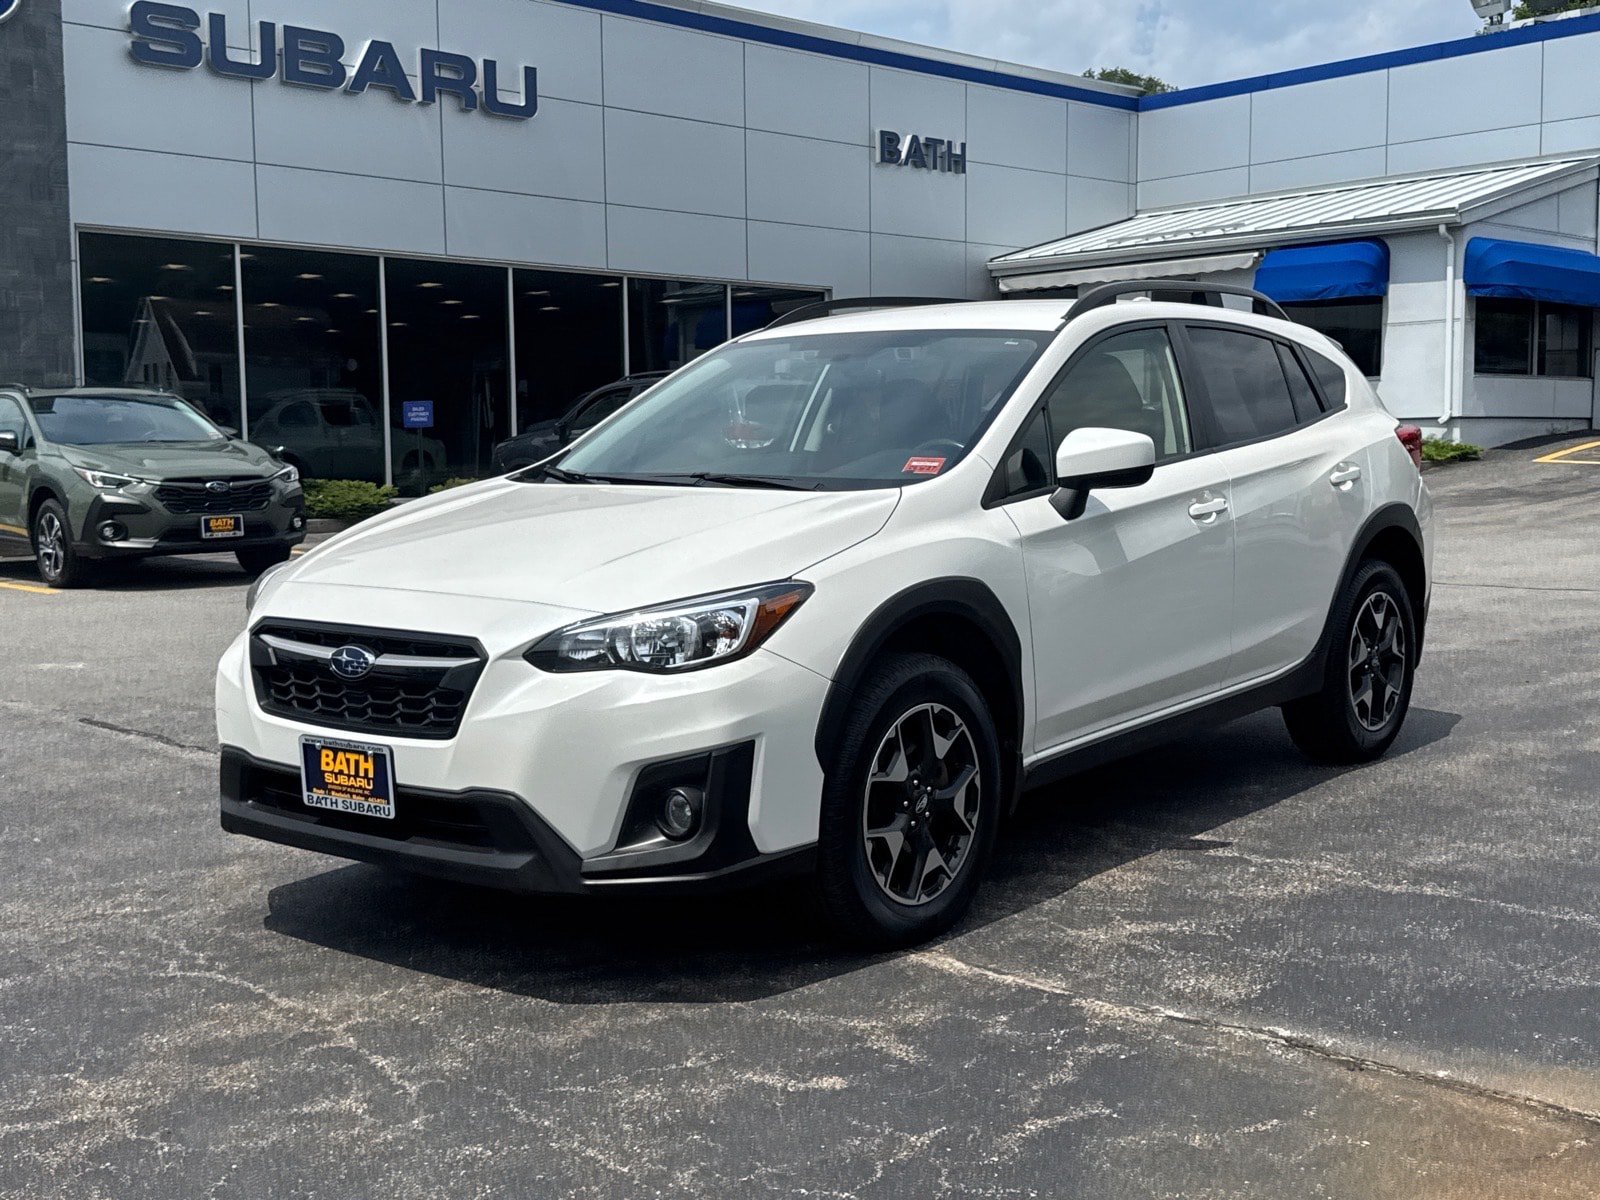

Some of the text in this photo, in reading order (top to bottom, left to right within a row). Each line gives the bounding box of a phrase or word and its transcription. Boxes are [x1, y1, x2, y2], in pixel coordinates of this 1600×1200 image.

[129, 0, 537, 119] SUBARU
[877, 130, 966, 174] BATH
[210, 518, 234, 527] BATH
[320, 748, 374, 778] BATH
[324, 772, 374, 790] SUBARU
[307, 794, 339, 808] BATH
[341, 799, 391, 817] SUBARU
